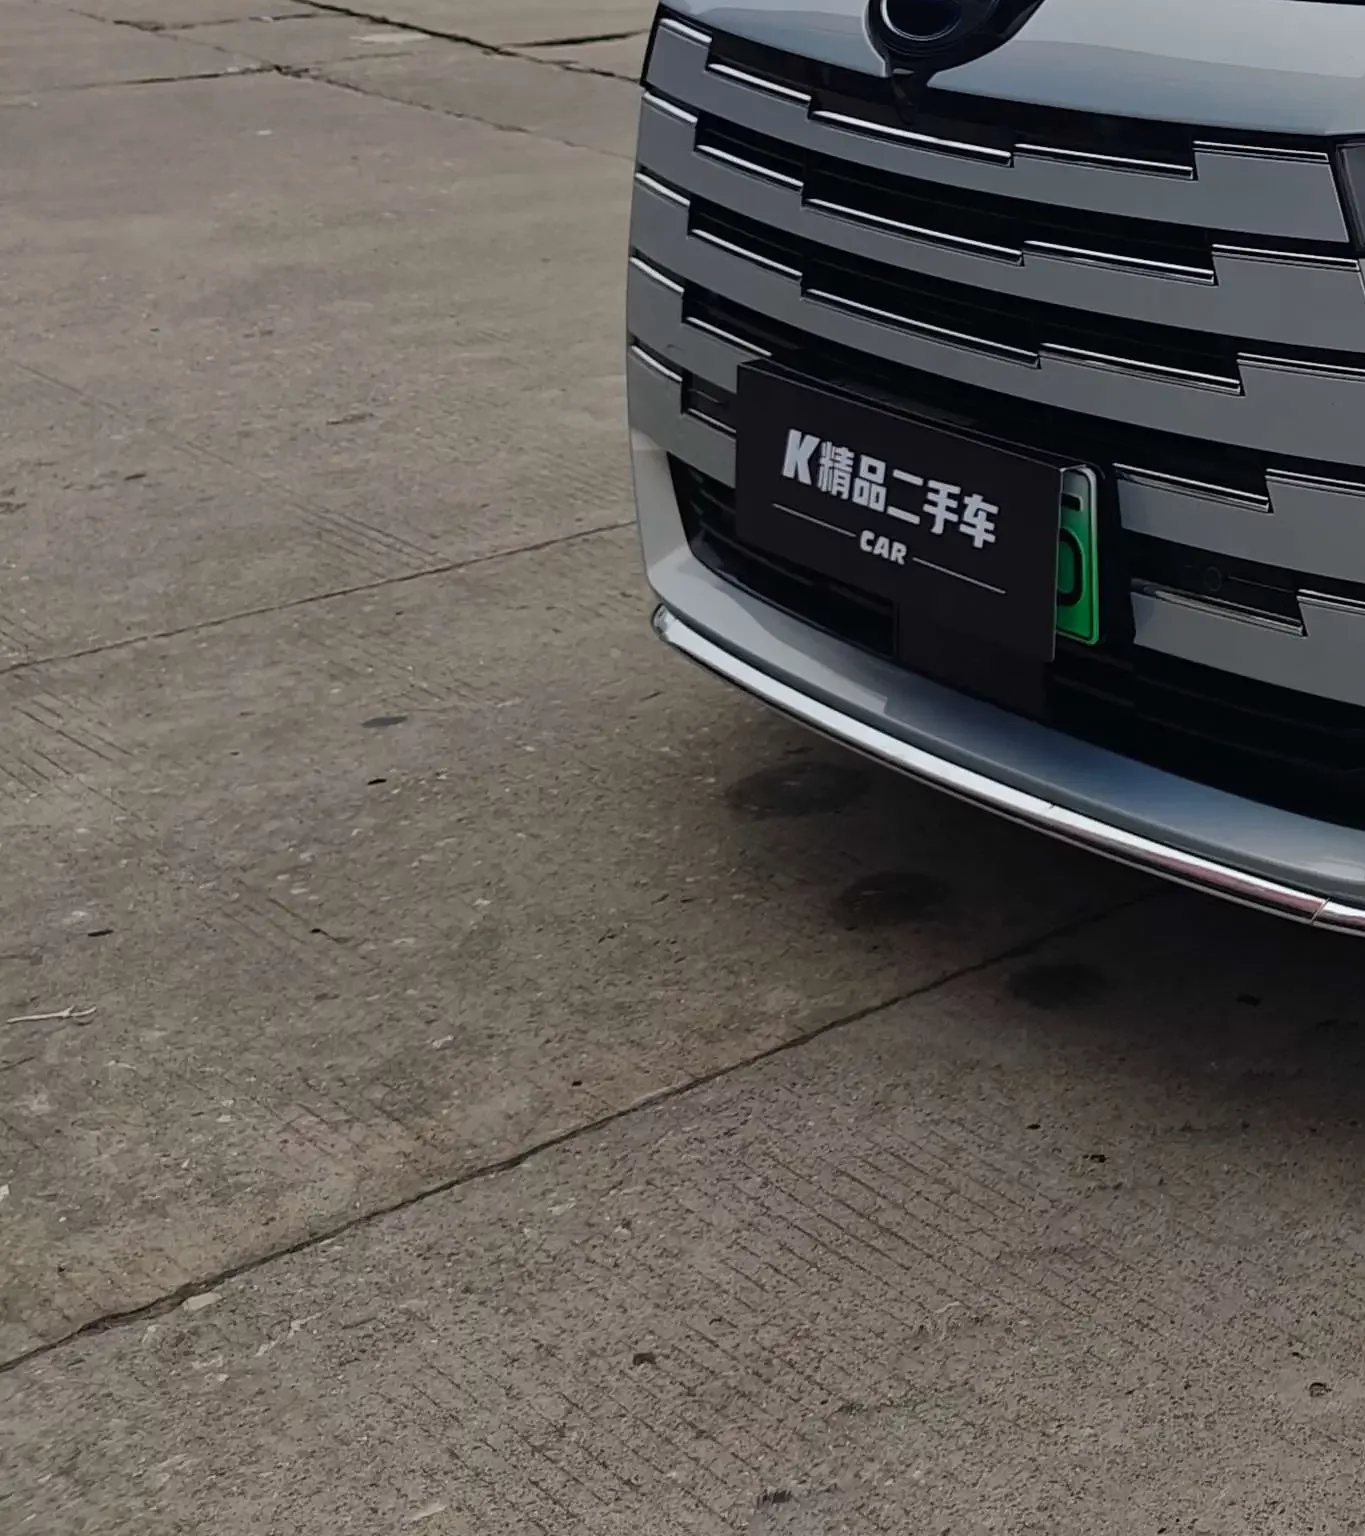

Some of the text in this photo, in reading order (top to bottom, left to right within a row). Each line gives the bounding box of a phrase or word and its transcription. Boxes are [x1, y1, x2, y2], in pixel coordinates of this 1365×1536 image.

[782, 429, 999, 549] K精品二手车
[860, 530, 907, 565] CAR
